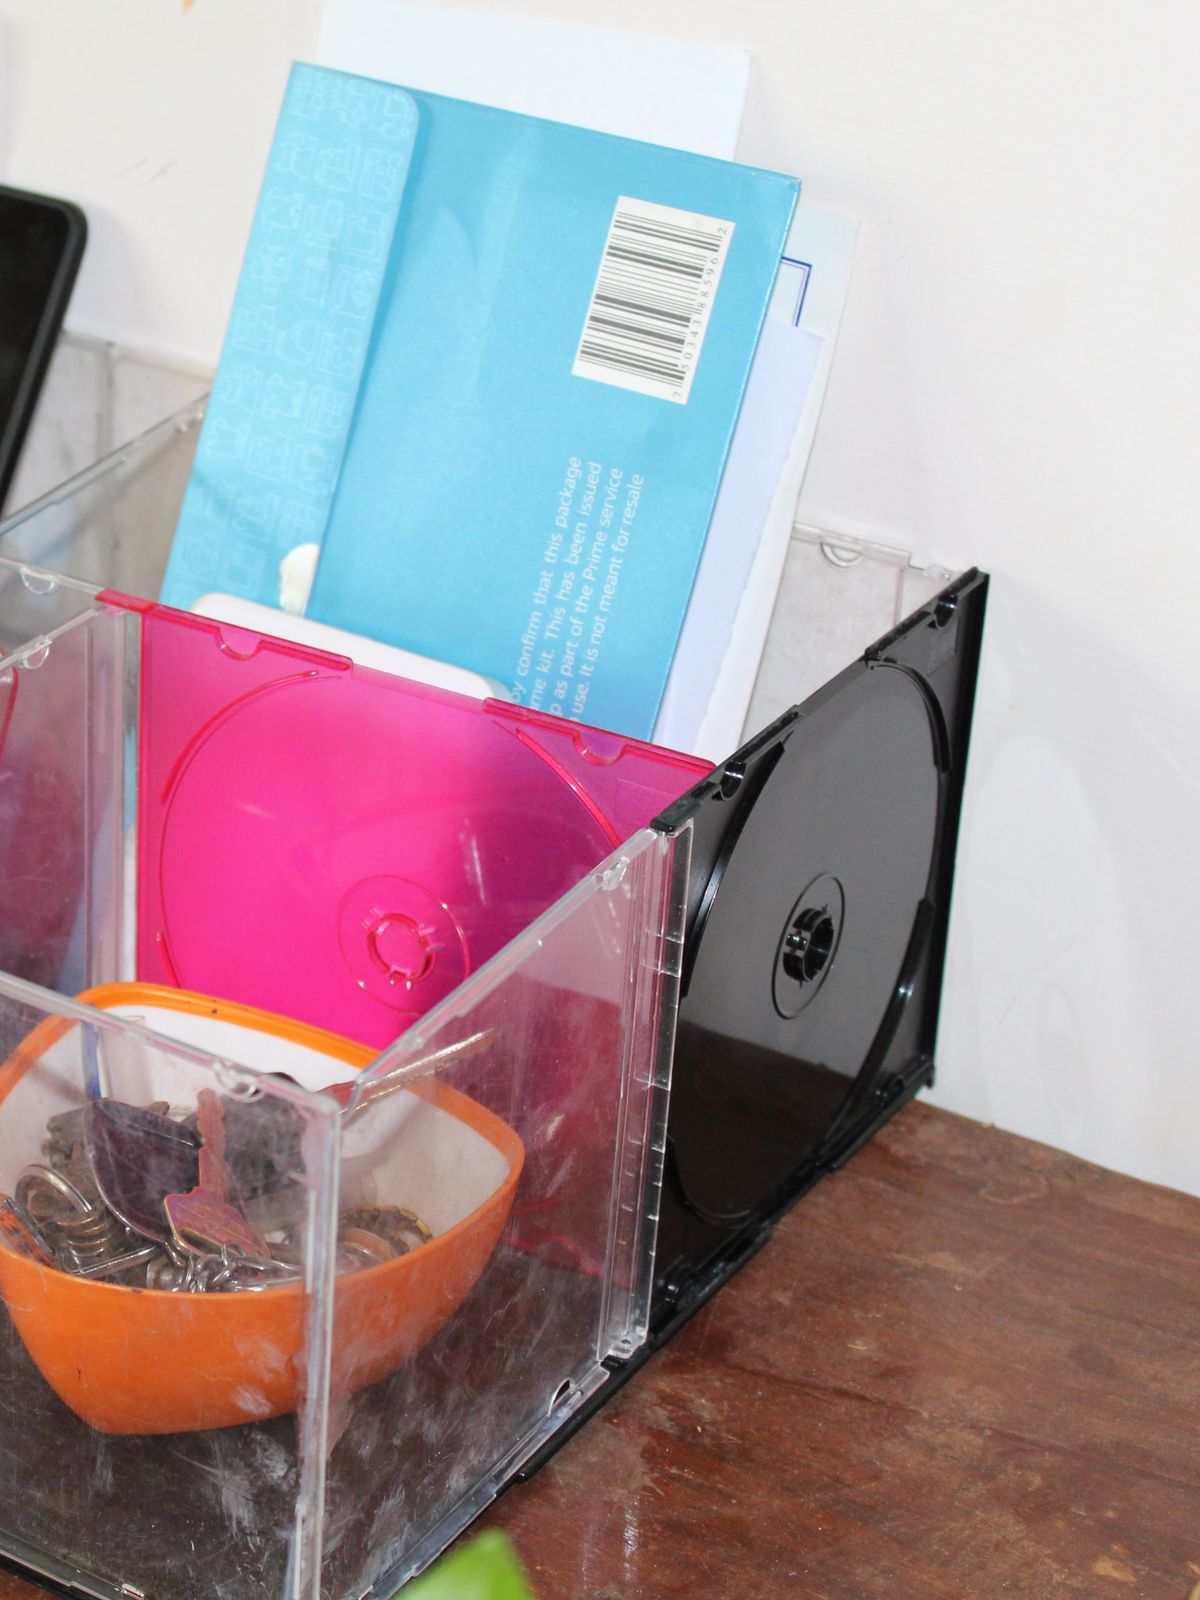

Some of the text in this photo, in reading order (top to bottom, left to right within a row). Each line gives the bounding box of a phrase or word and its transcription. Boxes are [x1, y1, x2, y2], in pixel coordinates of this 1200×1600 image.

[577, 461, 602, 516] issued
[599, 468, 623, 527] service
[621, 474, 644, 525] resale
[563, 522, 588, 566] been
[581, 531, 608, 581] Prime
[611, 528, 630, 553] for
[516, 612, 543, 676] confirm
[532, 570, 554, 605] that
[543, 532, 563, 564] this
[555, 456, 582, 528] package
[554, 571, 576, 601] has
[574, 585, 593, 614] the
[597, 556, 624, 613] meant
[543, 607, 567, 639] This
[570, 616, 584, 637] of
[590, 615, 608, 645] not
[535, 649, 555, 673] kit.
[560, 641, 579, 678] part
[579, 663, 594, 677] It
[583, 648, 599, 661] is
[554, 681, 569, 699] as
[571, 682, 591, 714] use.
